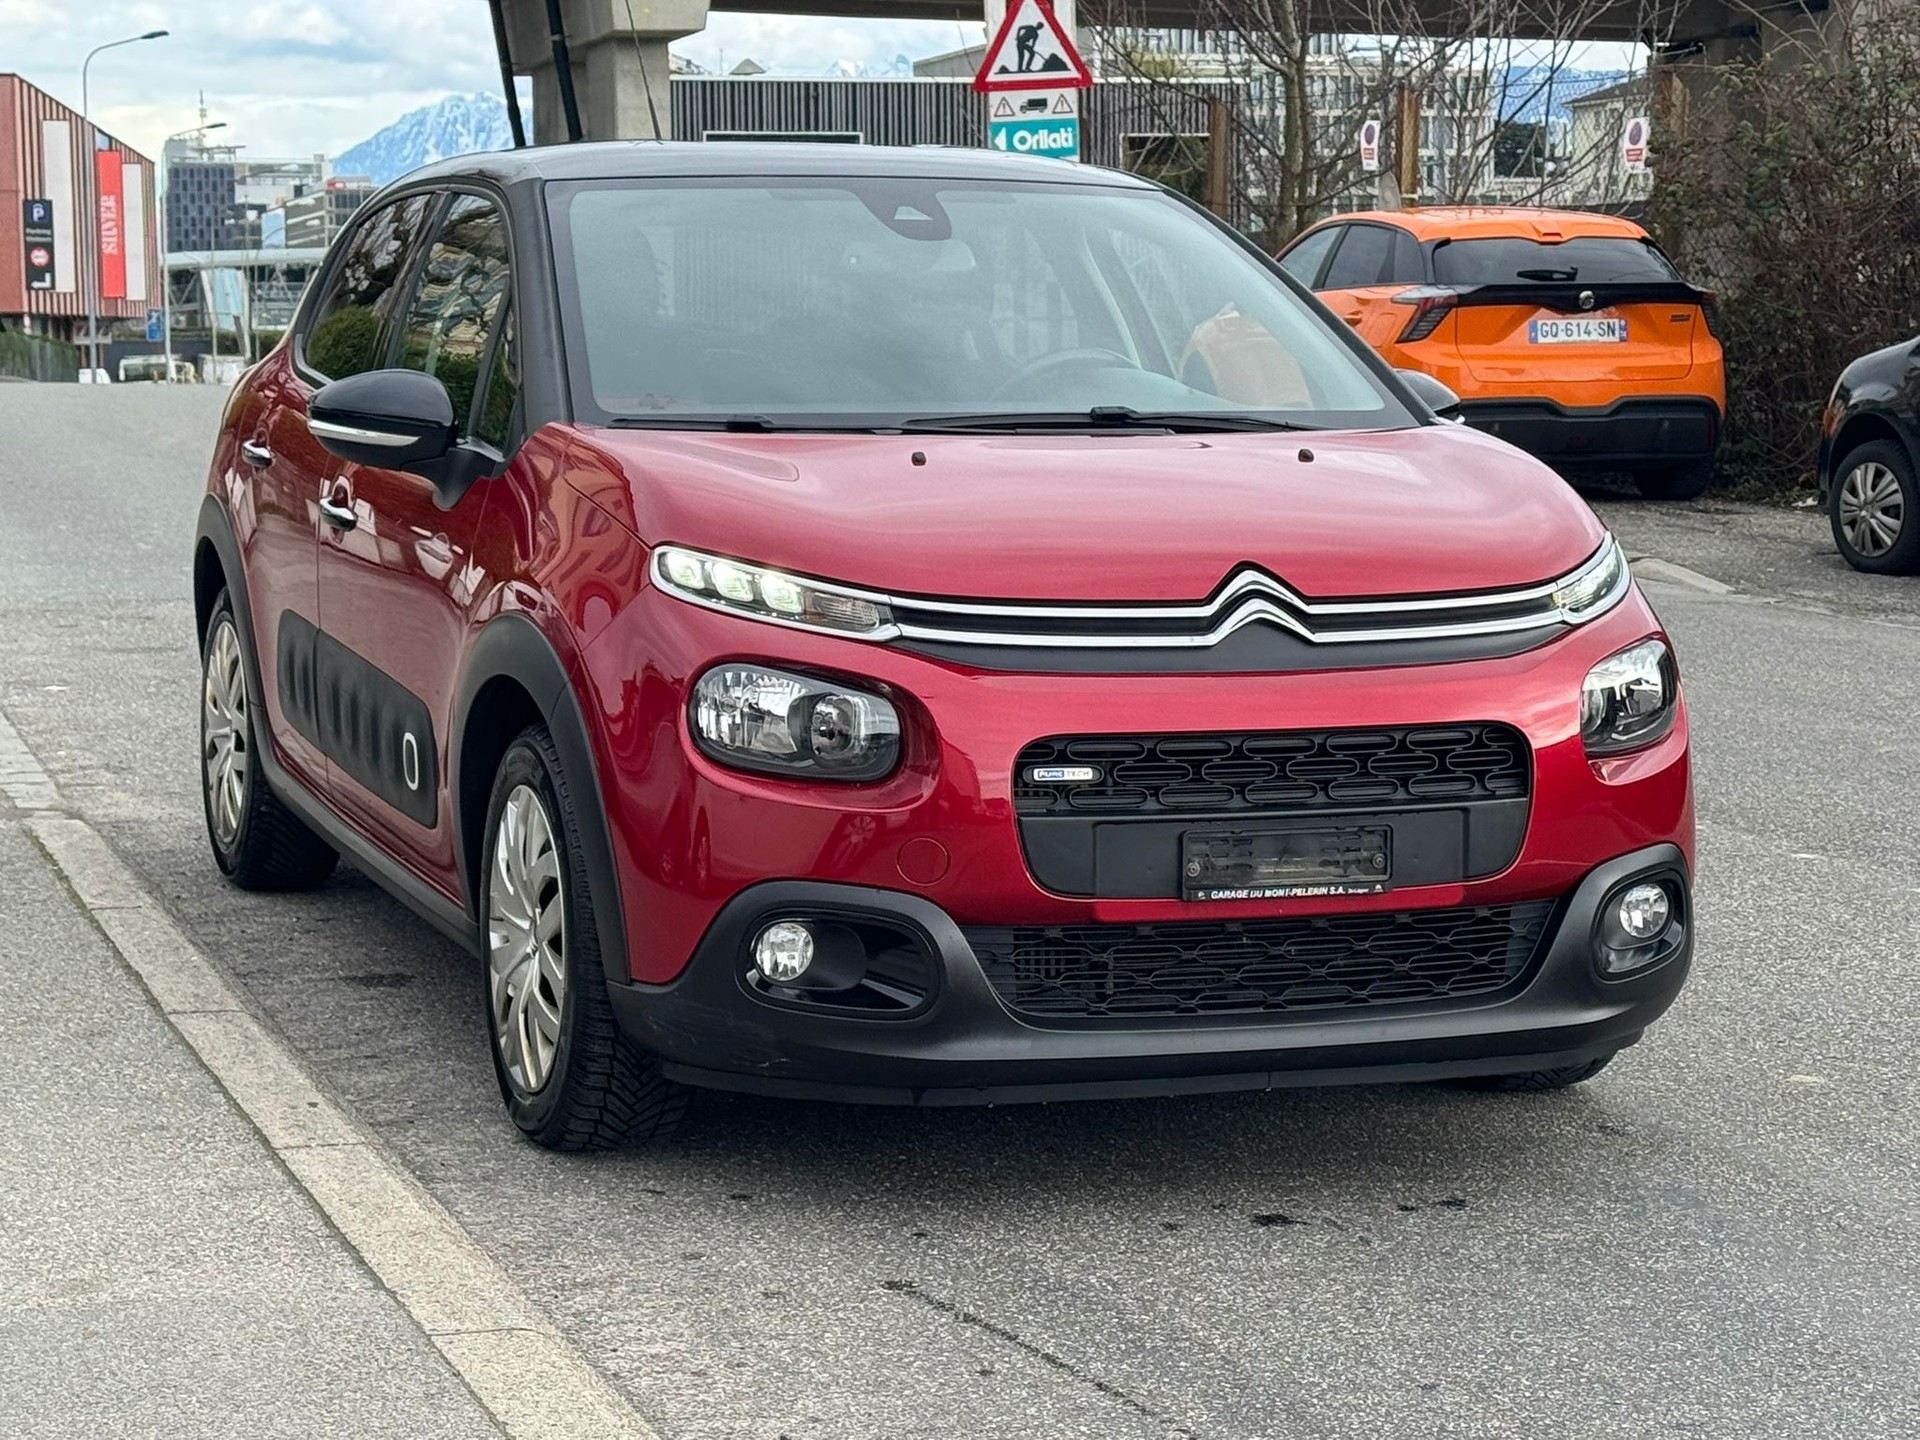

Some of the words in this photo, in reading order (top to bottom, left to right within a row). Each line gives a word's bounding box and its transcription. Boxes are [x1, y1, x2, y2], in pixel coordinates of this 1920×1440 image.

[1013, 127, 1074, 151] Orllati
[32, 206, 45, 223] P
[1540, 321, 1616, 338] GQ-614-SN
[1211, 889, 1249, 899] GARAGE
[1250, 889, 1263, 898] DU
